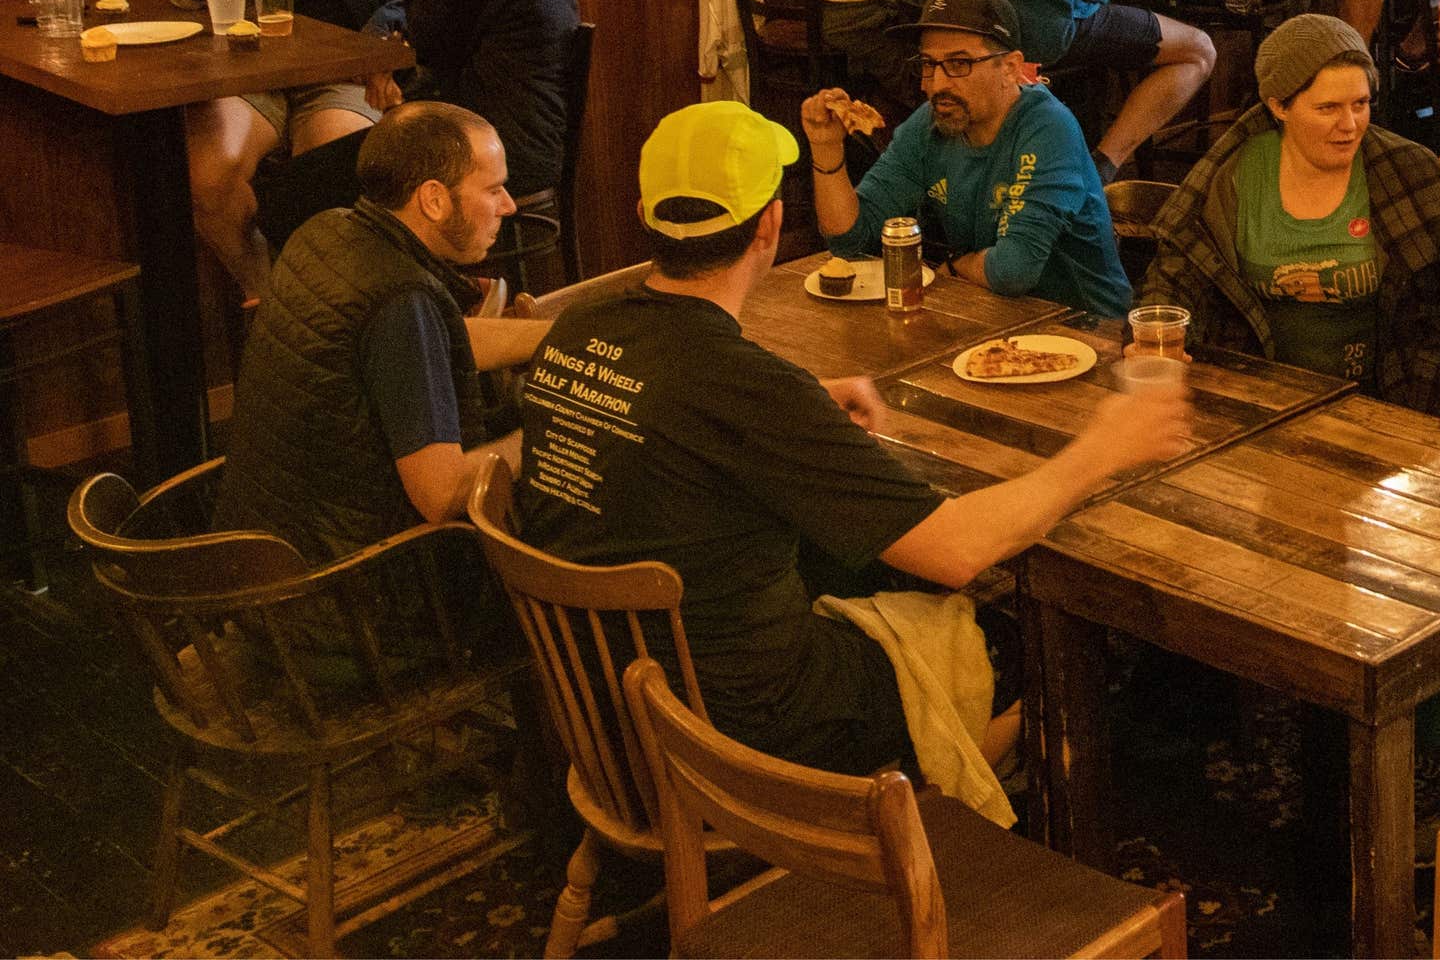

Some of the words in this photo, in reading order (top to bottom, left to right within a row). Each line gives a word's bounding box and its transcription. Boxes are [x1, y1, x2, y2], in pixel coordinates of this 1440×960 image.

[586, 338, 623, 361] 2019
[543, 345, 585, 373] WINGS
[584, 362, 597, 377] &
[597, 365, 644, 393] WHEELS
[532, 367, 568, 390] HALF
[570, 380, 631, 415] MARATHON
[576, 411, 603, 427] CHAMBER
[603, 422, 611, 431] OF
[545, 430, 558, 441] CITY
[558, 434, 566, 443] OF
